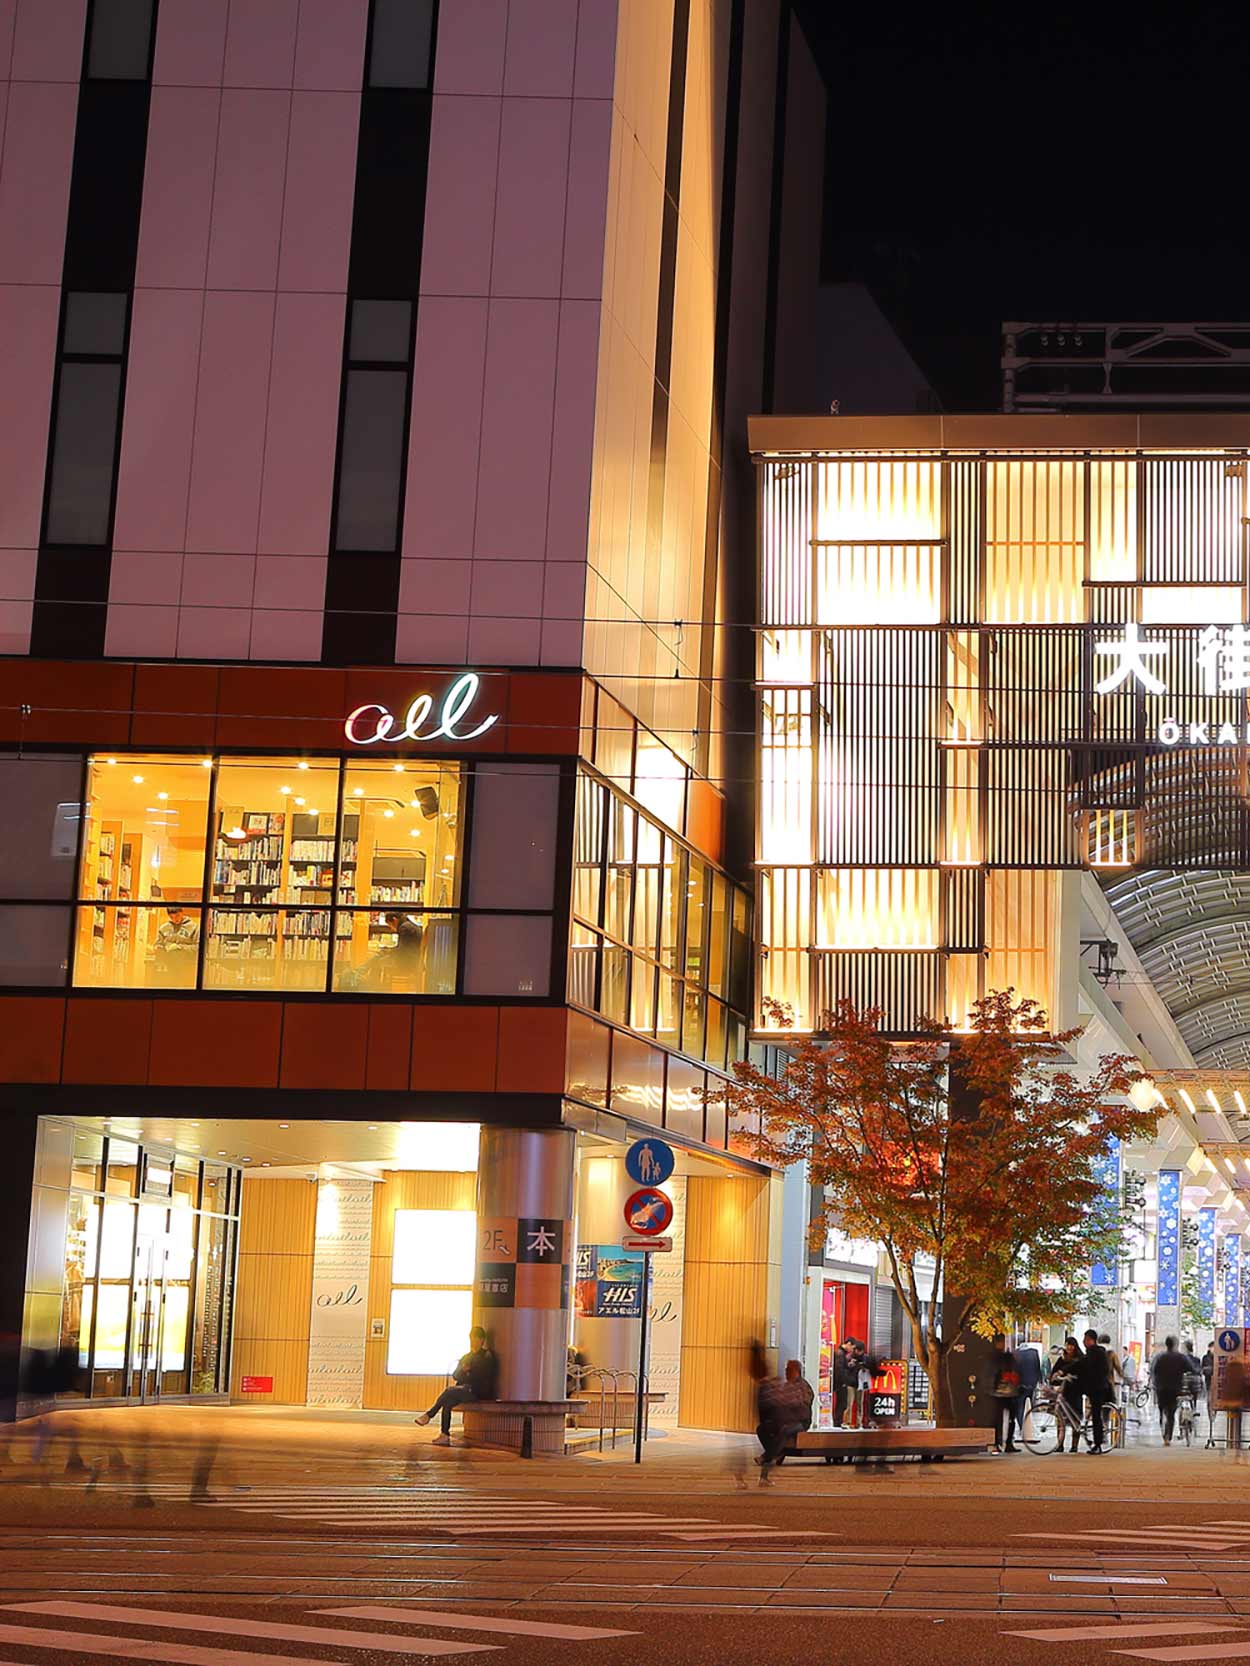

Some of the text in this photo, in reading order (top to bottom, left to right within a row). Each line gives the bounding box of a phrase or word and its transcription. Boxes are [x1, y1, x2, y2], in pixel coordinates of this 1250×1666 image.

[483, 1229, 504, 1251] 2F
[526, 1225, 556, 1257] 本
[603, 1287, 637, 1303] HIS
[874, 1396, 896, 1407] 24h
[873, 1408, 896, 1416] OPEN
